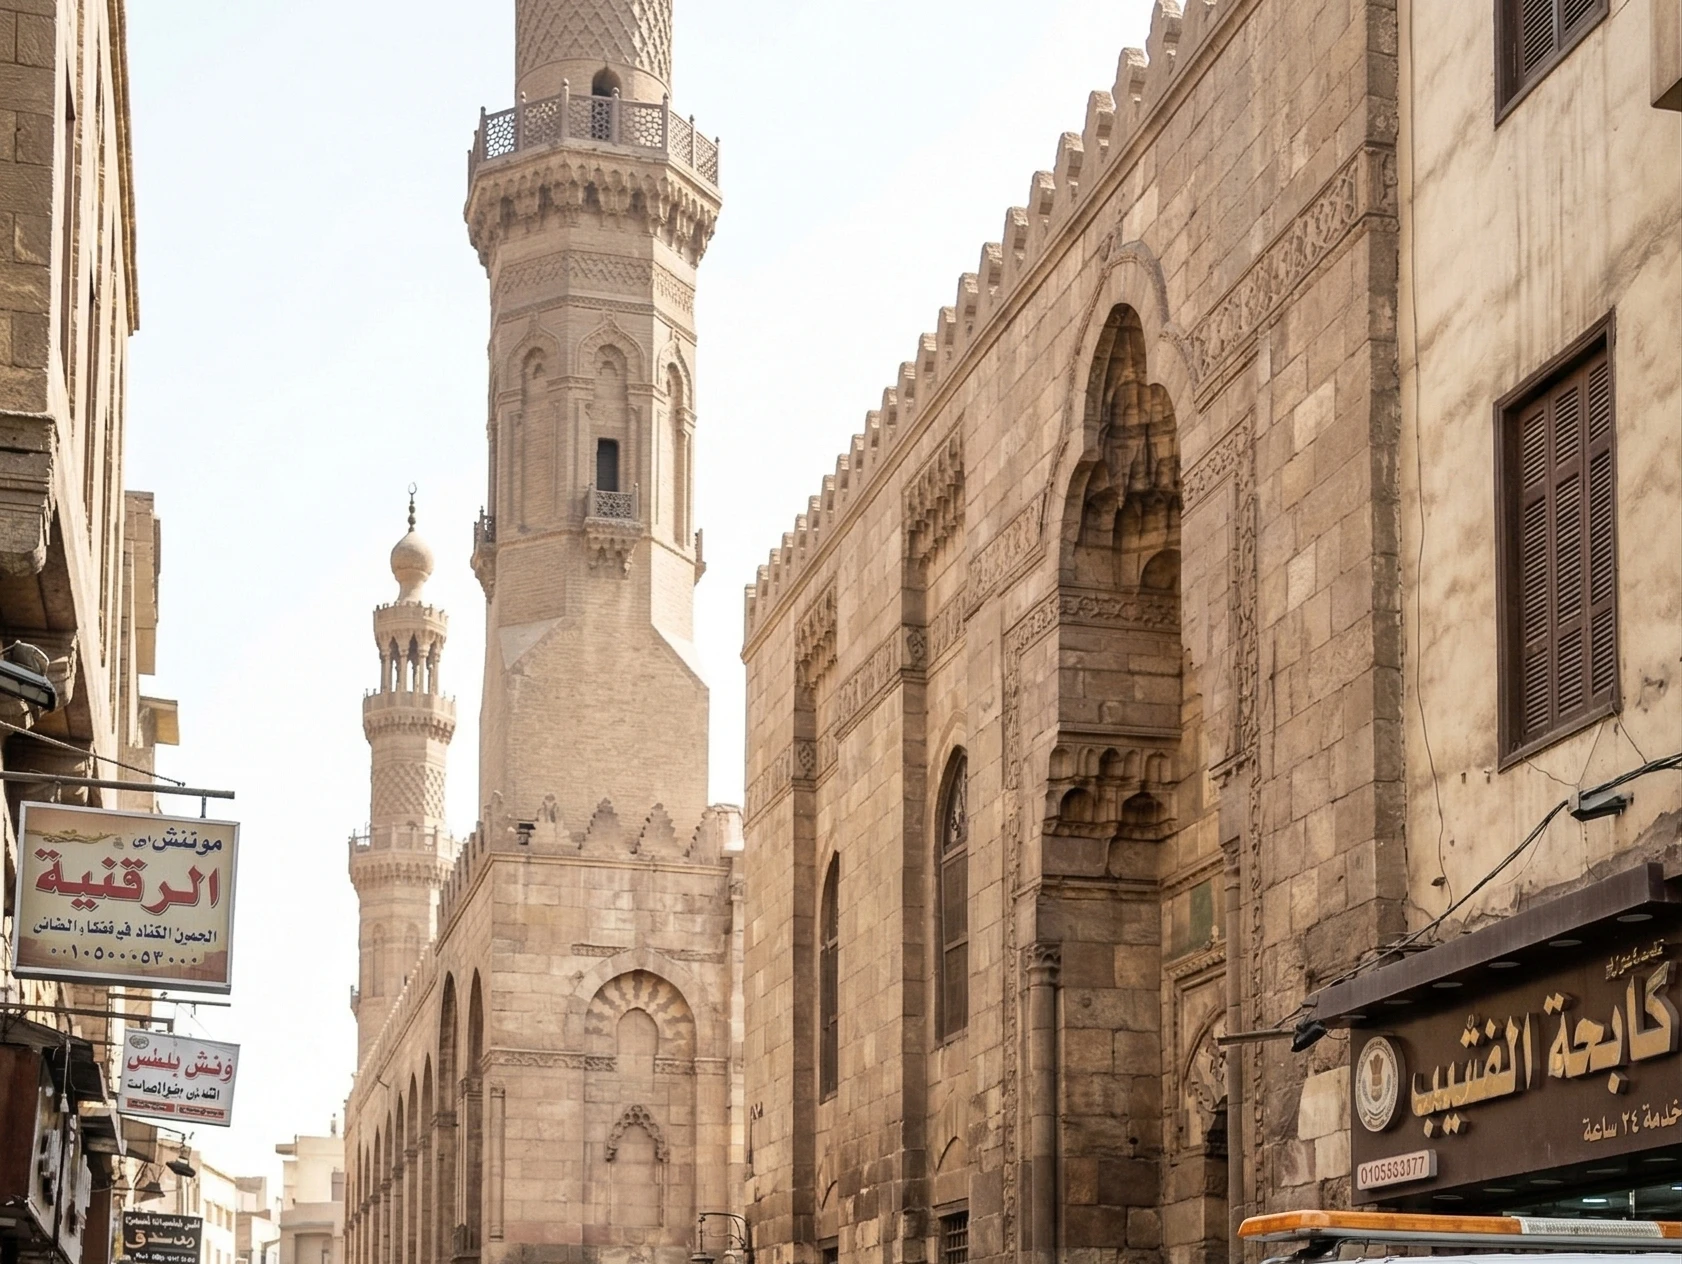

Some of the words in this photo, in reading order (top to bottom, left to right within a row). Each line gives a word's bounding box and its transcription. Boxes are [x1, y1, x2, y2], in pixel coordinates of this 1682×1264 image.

[34, 847, 220, 916] الرقنية
[1582, 1115, 1617, 1142] ساعة
[1621, 1109, 1639, 1135] ٢٤
